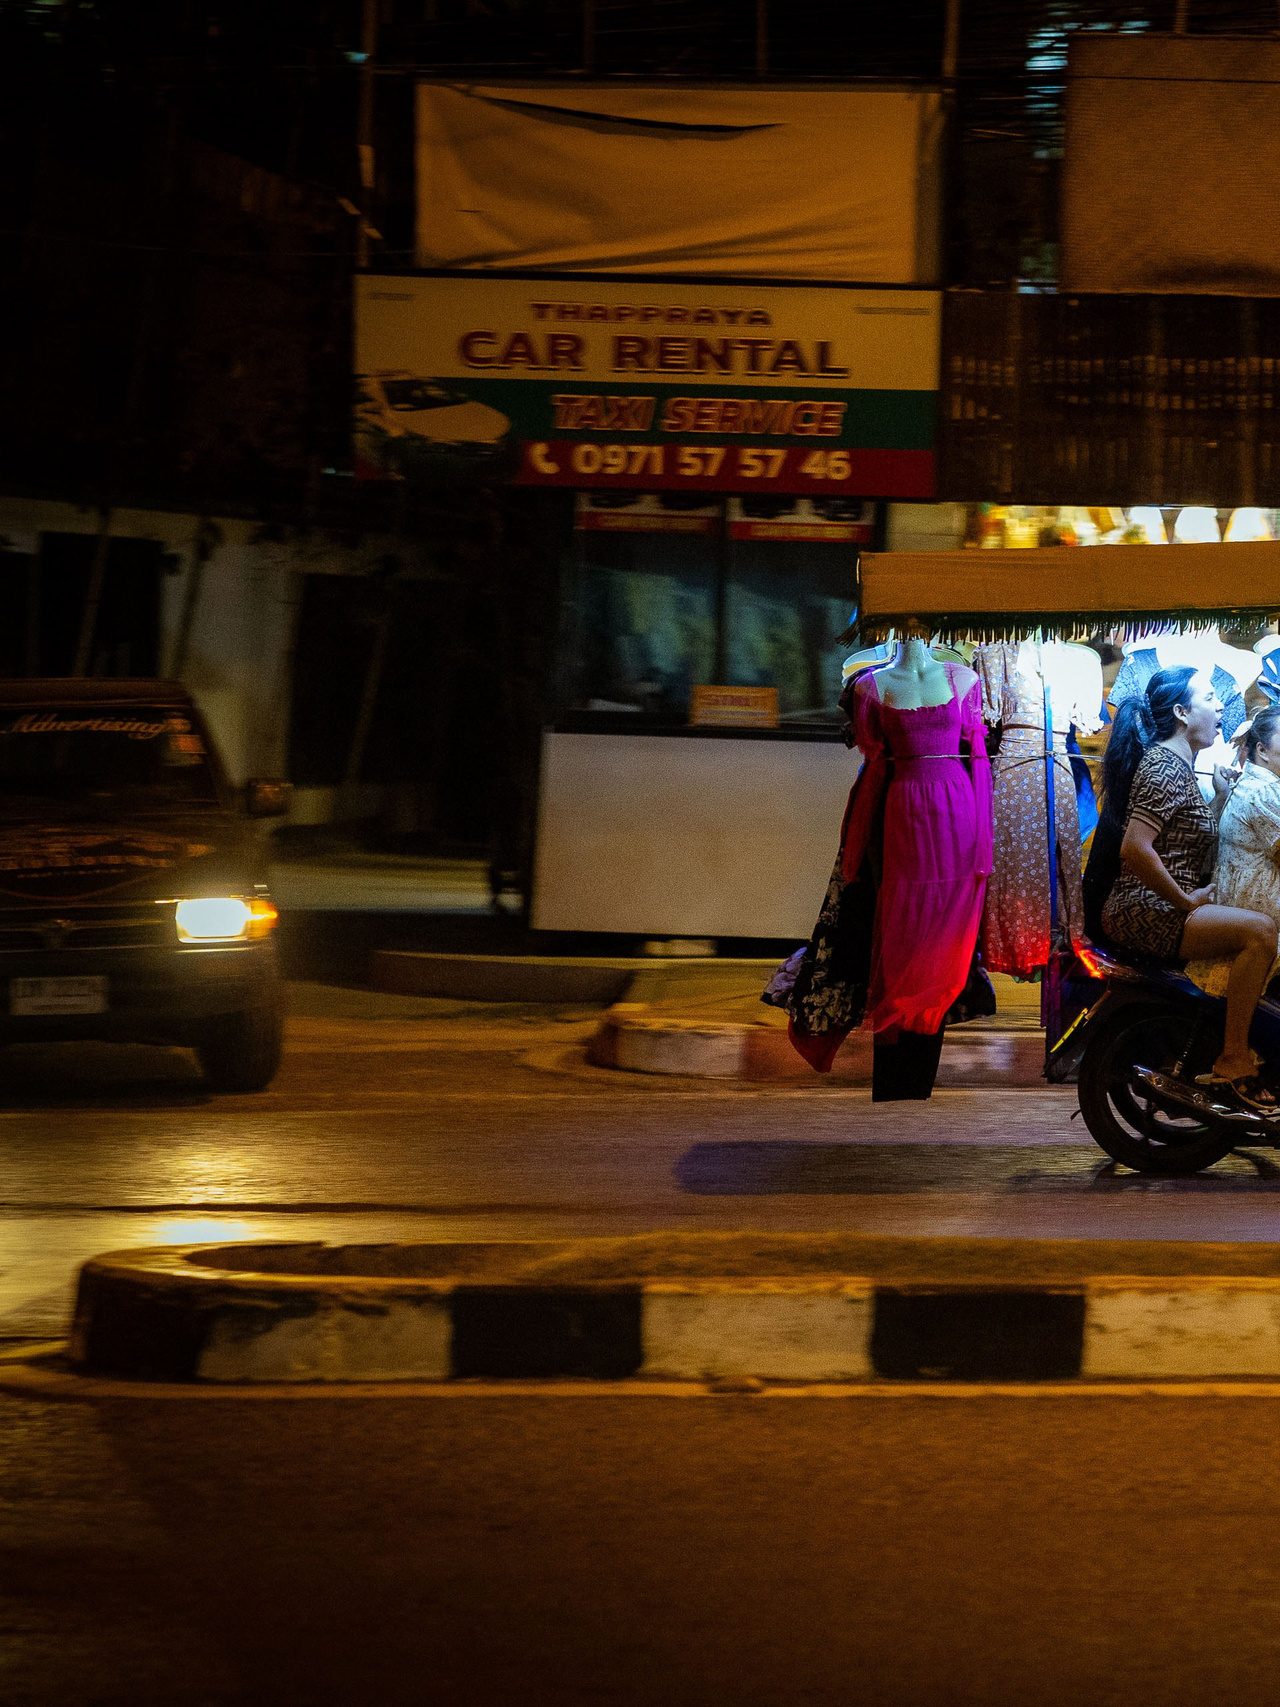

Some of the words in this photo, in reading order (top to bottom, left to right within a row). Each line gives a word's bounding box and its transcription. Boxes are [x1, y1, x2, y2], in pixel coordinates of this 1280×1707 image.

[530, 302, 772, 327] THAPPRAYA
[458, 330, 588, 372] CAR
[610, 334, 851, 379] RENTAL
[551, 394, 657, 432] TAXI
[660, 397, 849, 438] SERVICE
[571, 444, 667, 476] 0971
[675, 447, 728, 477] 57
[737, 449, 789, 479] 57
[798, 451, 853, 481] 46
